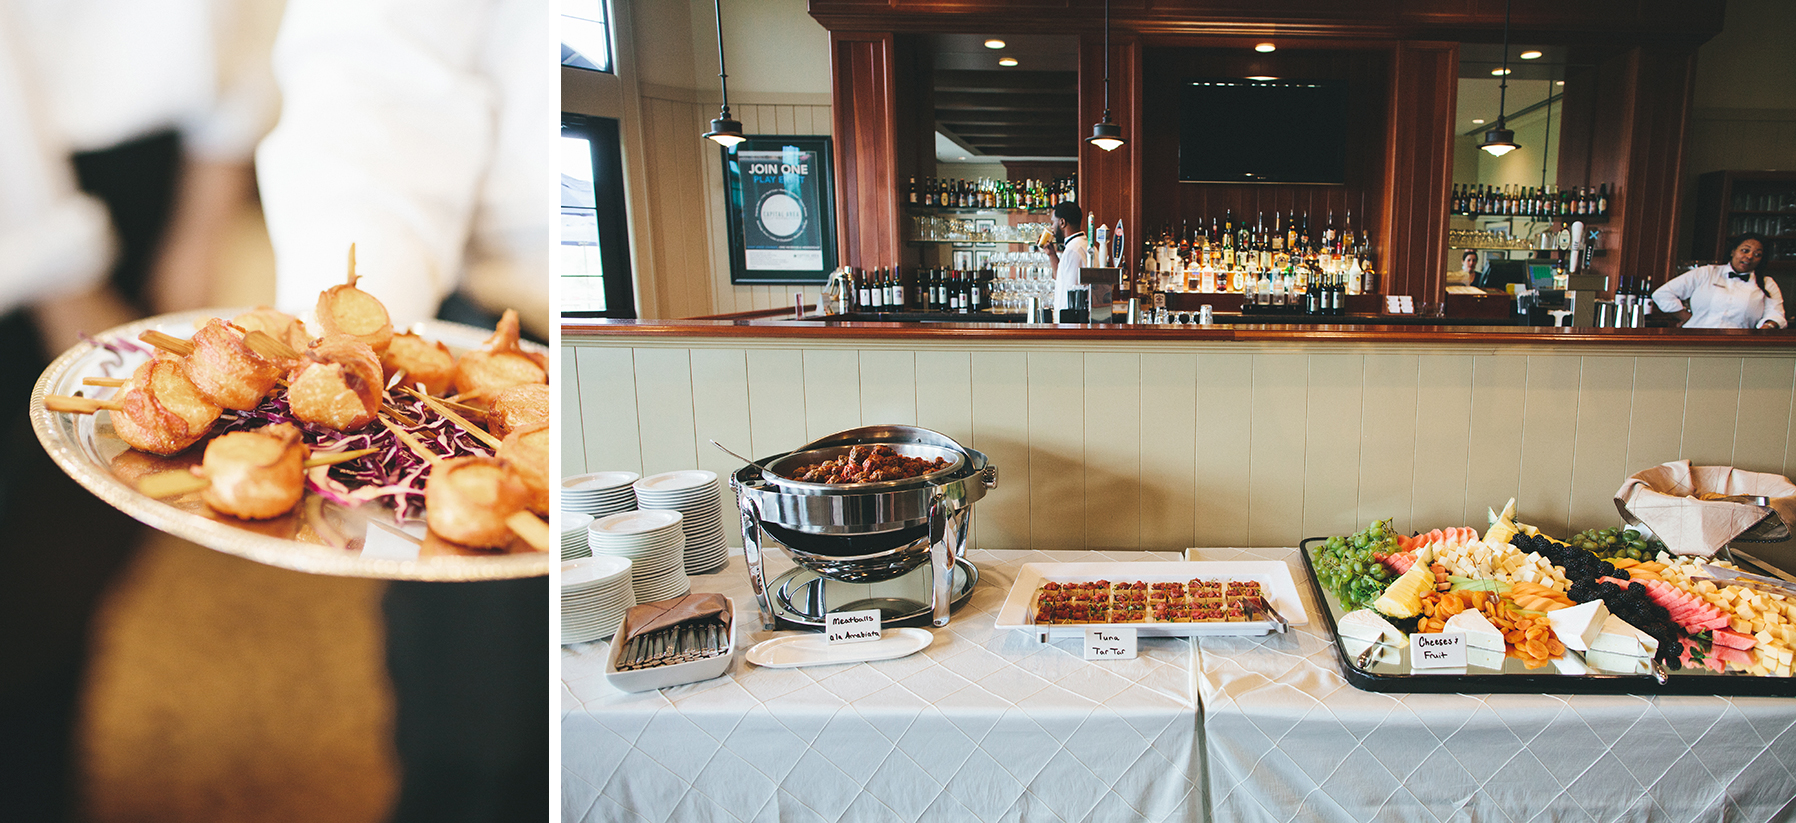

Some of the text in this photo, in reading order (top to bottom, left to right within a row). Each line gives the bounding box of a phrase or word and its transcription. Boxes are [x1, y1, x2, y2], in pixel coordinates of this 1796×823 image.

[748, 164, 808, 174] JOIN ONE
[753, 176, 776, 184] PLAY
[832, 616, 874, 624] Meatballs
[1094, 632, 1120, 640] Tuna
[1418, 636, 1452, 648] Cheeses
[1424, 651, 1448, 659] Fruit
